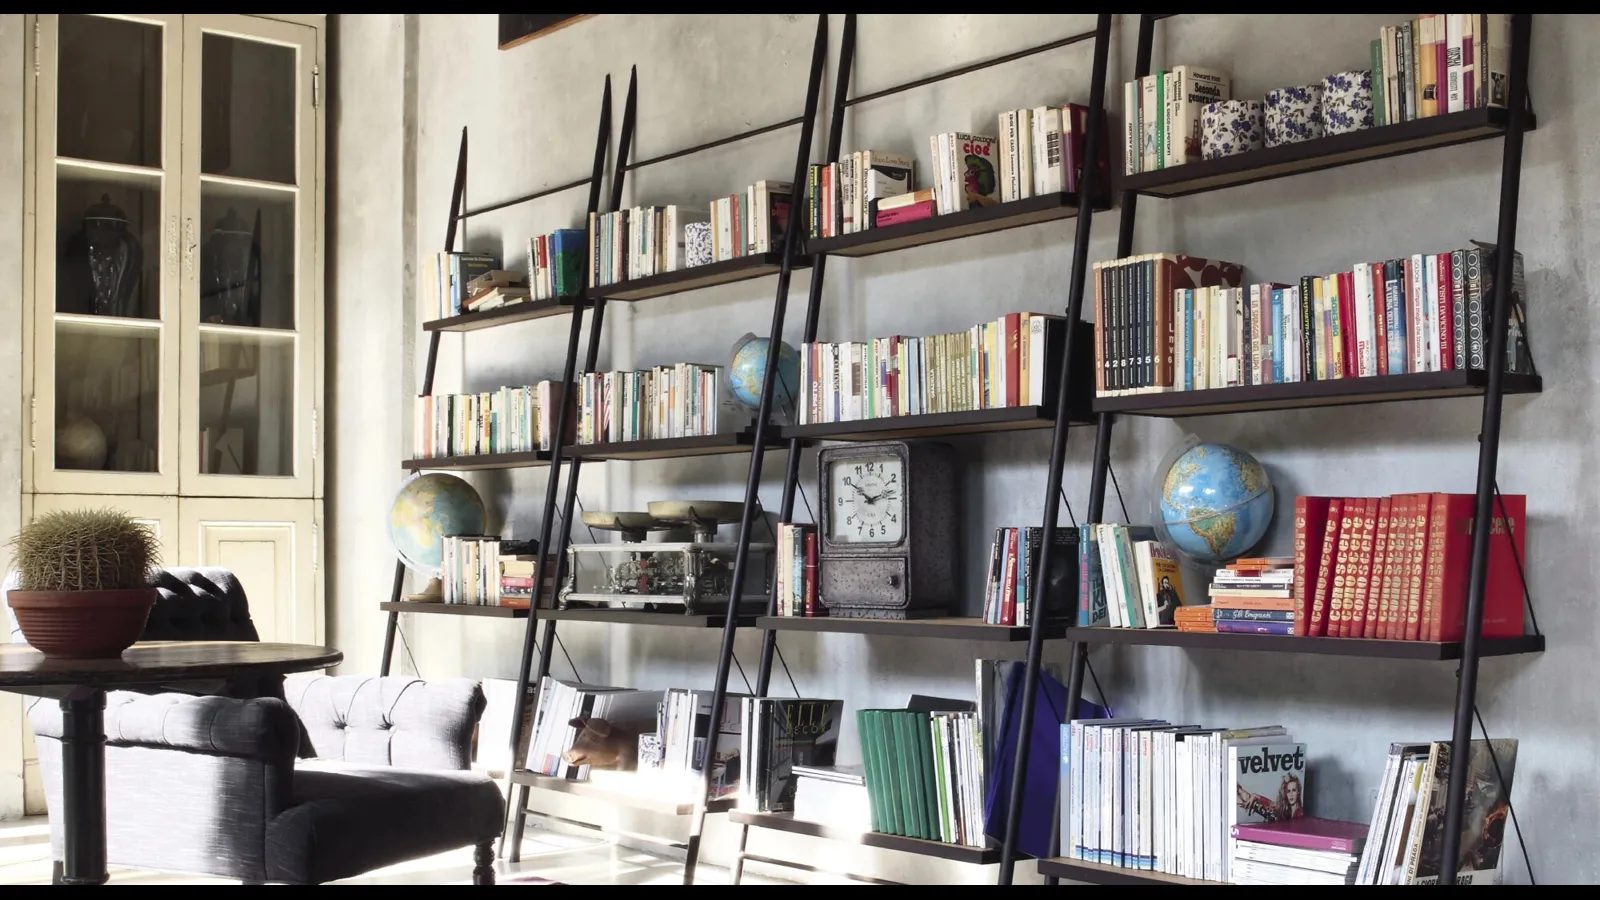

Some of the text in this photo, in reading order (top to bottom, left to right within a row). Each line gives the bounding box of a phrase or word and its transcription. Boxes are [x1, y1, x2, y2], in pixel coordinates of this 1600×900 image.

[1194, 82, 1220, 97] Seconda
[956, 132, 997, 144] LUCA GOLDONI
[963, 140, 990, 156] cioè
[1331, 296, 1339, 336] DIPENDE
[1440, 305, 1446, 316] DA
[1129, 358, 1134, 366] 7
[855, 465, 862, 475] 11
[865, 462, 874, 472] 12
[880, 464, 883, 473] 1
[842, 476, 852, 486] 10
[890, 473, 896, 483] 2
[838, 497, 843, 506] 9
[847, 516, 852, 525] 8
[891, 514, 897, 523] 4
[858, 527, 862, 535] 7
[869, 528, 874, 537] 6
[881, 525, 886, 535] 5
[1296, 516, 1306, 621] conoscere
[1312, 519, 1336, 622] conoscere
[1330, 517, 1352, 621] conoscere
[1341, 516, 1363, 621] conoscere
[1352, 518, 1375, 622] conoscere
[1367, 517, 1387, 621] conoscere
[1379, 517, 1398, 622] conoscere
[1388, 516, 1407, 622] conoscere
[1408, 515, 1426, 623] conoscere
[786, 704, 829, 727] ELLE
[786, 725, 826, 735] DECOR
[1238, 746, 1304, 774] velvet
[1231, 827, 1239, 836] 5
[1411, 843, 1419, 865] PRAGA
